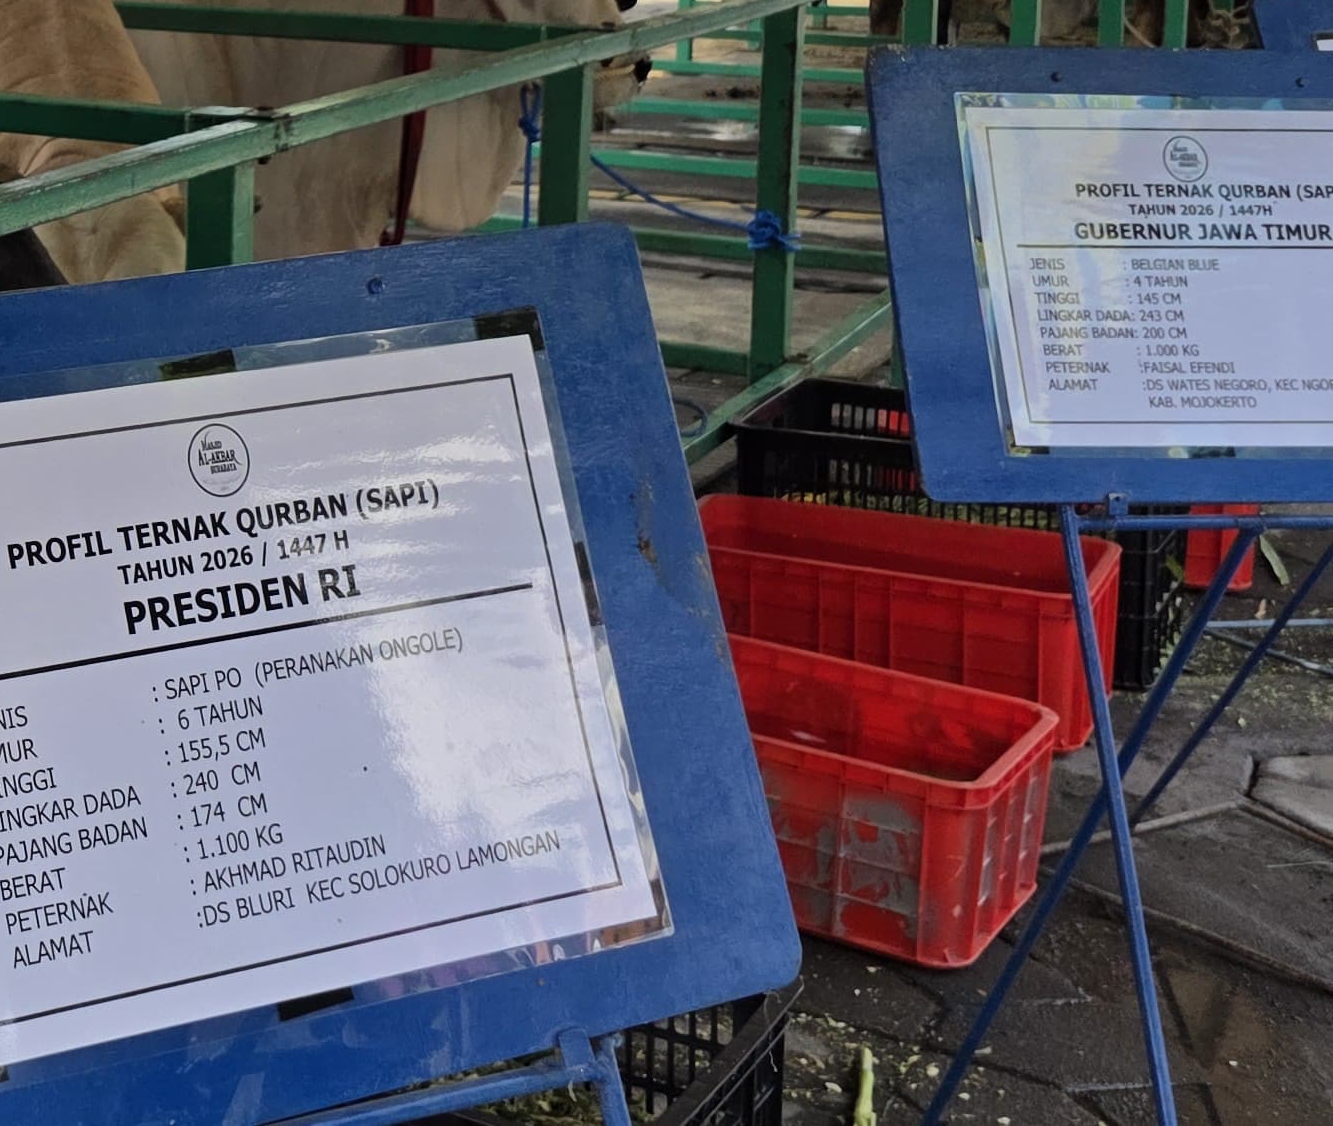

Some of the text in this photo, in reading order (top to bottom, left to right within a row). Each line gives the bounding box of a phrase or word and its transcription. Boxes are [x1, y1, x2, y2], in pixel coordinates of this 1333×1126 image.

[1075, 183, 1141, 198] PROFIL
[1144, 183, 1214, 199] TERNAK
[1218, 184, 1292, 201] QURBAN
[1128, 204, 1176, 217] TAHUN
[1181, 204, 1214, 216] 2026
[1229, 204, 1273, 216] 1447H
[1075, 222, 1332, 241] GUBERNUR JAWA TIMUR
[1029, 258, 1065, 270] JENIS
[1131, 258, 1185, 271] BELGIAN
[1188, 259, 1219, 271] BLUE
[1033, 275, 1069, 287] UMUR
[1134, 276, 1142, 287] 4
[1146, 276, 1188, 288] TAHUN
[1035, 292, 1080, 305] TINGGI
[1137, 293, 1159, 305] 145
[1162, 293, 1182, 305] CM
[1037, 310, 1093, 322] LINGKAR
[1139, 310, 1162, 322] 243
[1165, 310, 1185, 322] CM
[1040, 327, 1088, 339] PAJANG
[1142, 327, 1165, 339] 200
[1168, 327, 1188, 339] CM
[1043, 344, 1083, 356] BERAT
[1146, 344, 1179, 357] 1.000
[1182, 344, 1200, 357] KG
[1045, 361, 1111, 374] PETERNAK
[1190, 361, 1236, 374] EFENDI
[1048, 378, 1098, 391] ALAMAT
[1167, 379, 1211, 391] WATES
[1214, 379, 1272, 393] NEGORO,
[1275, 379, 1299, 391] KEC
[1148, 396, 1257, 409] KAB. MOJOKERTO
[7, 478, 440, 569] PROFIL TERNAK QURBAN (SAPI)
[117, 530, 350, 585] TAHUN 2026 / 1447 H
[124, 564, 361, 635] PRESIDEN RI
[165, 672, 211, 700] SAPI
[215, 667, 242, 692] PO
[254, 642, 374, 689] (PERANAKAN
[379, 627, 463, 661] ONGOLE)
[177, 708, 190, 731] 6
[193, 695, 264, 727] TAHUN
[178, 737, 230, 764] 155,5
[236, 728, 267, 751] CM
[83, 785, 141, 815] DADA
[185, 770, 219, 795] 240
[231, 761, 261, 786] CM
[78, 817, 148, 851] BADAN
[190, 802, 226, 827] 174
[237, 793, 268, 817] CM
[0, 867, 66, 901] BERAT
[197, 830, 250, 860] 1.100
[254, 823, 283, 848] KG
[5, 892, 114, 935] PETERNAK
[203, 856, 286, 893] AKHMAD
[292, 834, 386, 874] RITAUDIN
[13, 930, 93, 969] ALAMAT
[236, 887, 295, 920] BLURI
[306, 876, 345, 905] KEC
[348, 854, 452, 894] SOLOKURO
[455, 829, 561, 872] LAMONGAN
